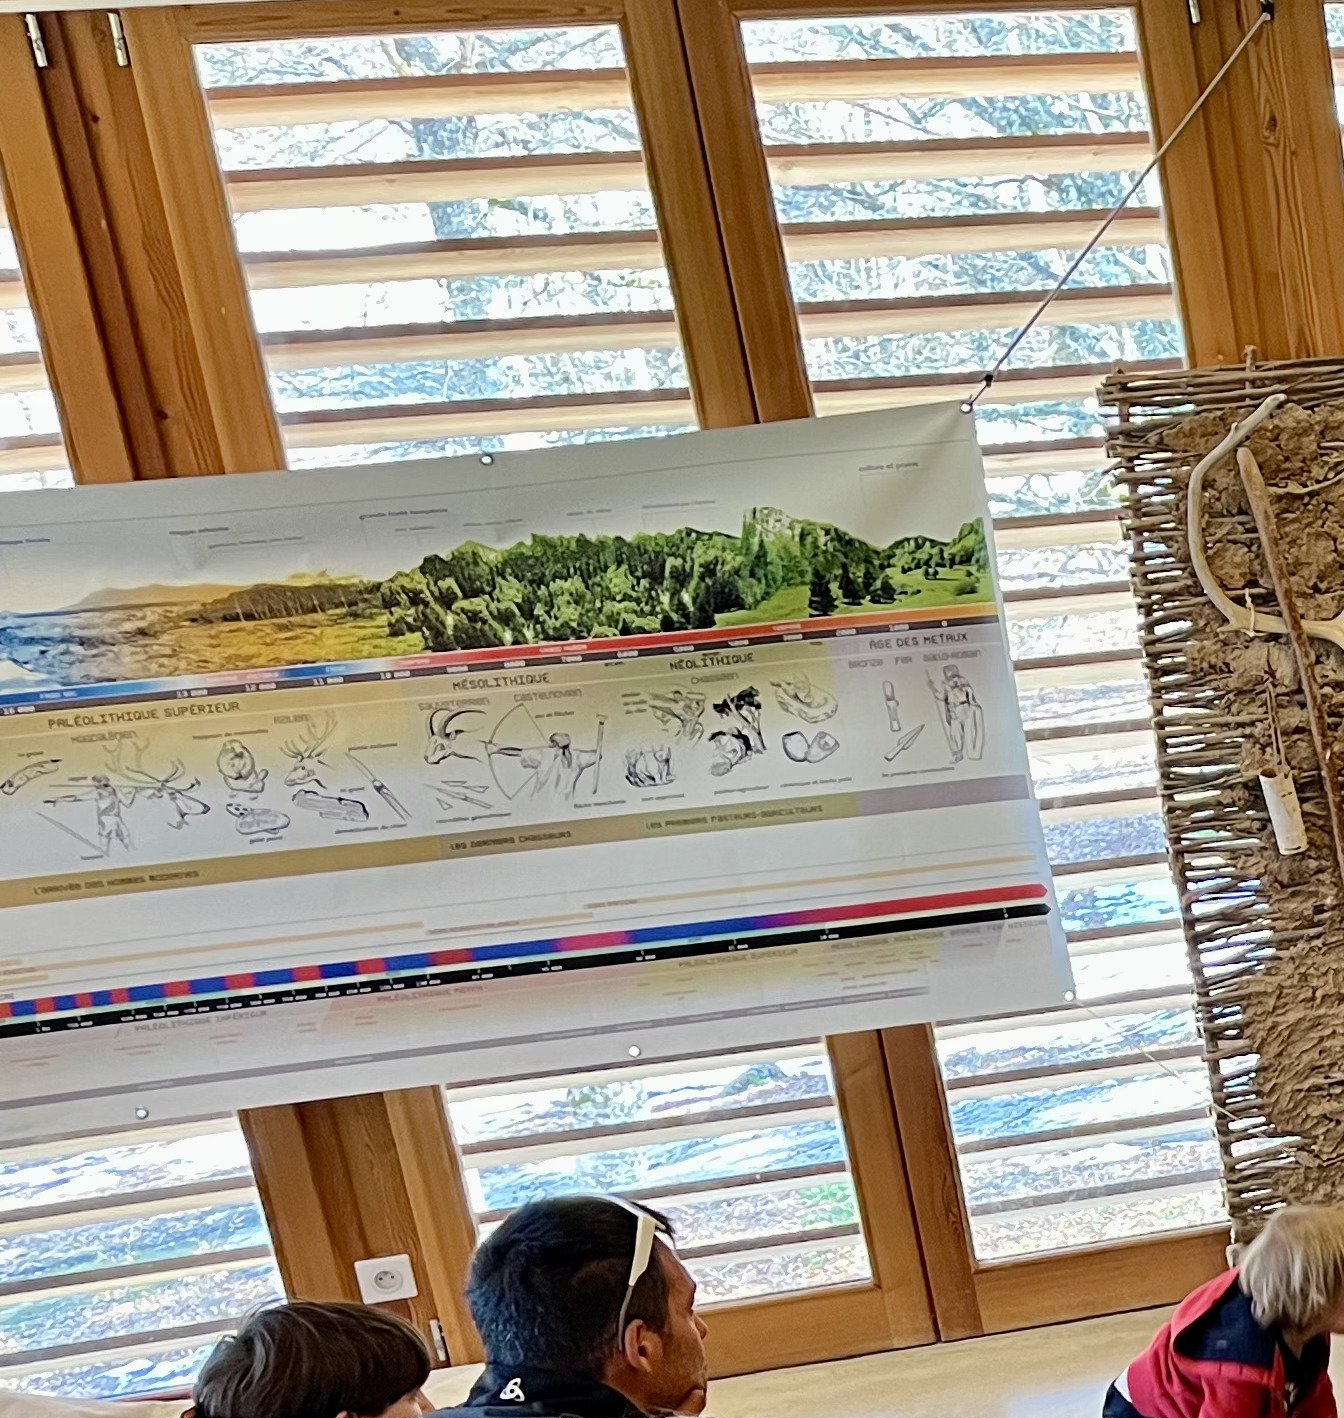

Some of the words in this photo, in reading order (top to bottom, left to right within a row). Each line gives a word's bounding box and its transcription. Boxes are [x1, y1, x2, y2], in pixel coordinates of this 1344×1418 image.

[896, 637, 920, 648] DES
[453, 673, 551, 691] MÉSOLITHIQUE
[48, 707, 159, 730] PALÉOLITHIQUE
[164, 701, 241, 719] SUPÉRIEUR
